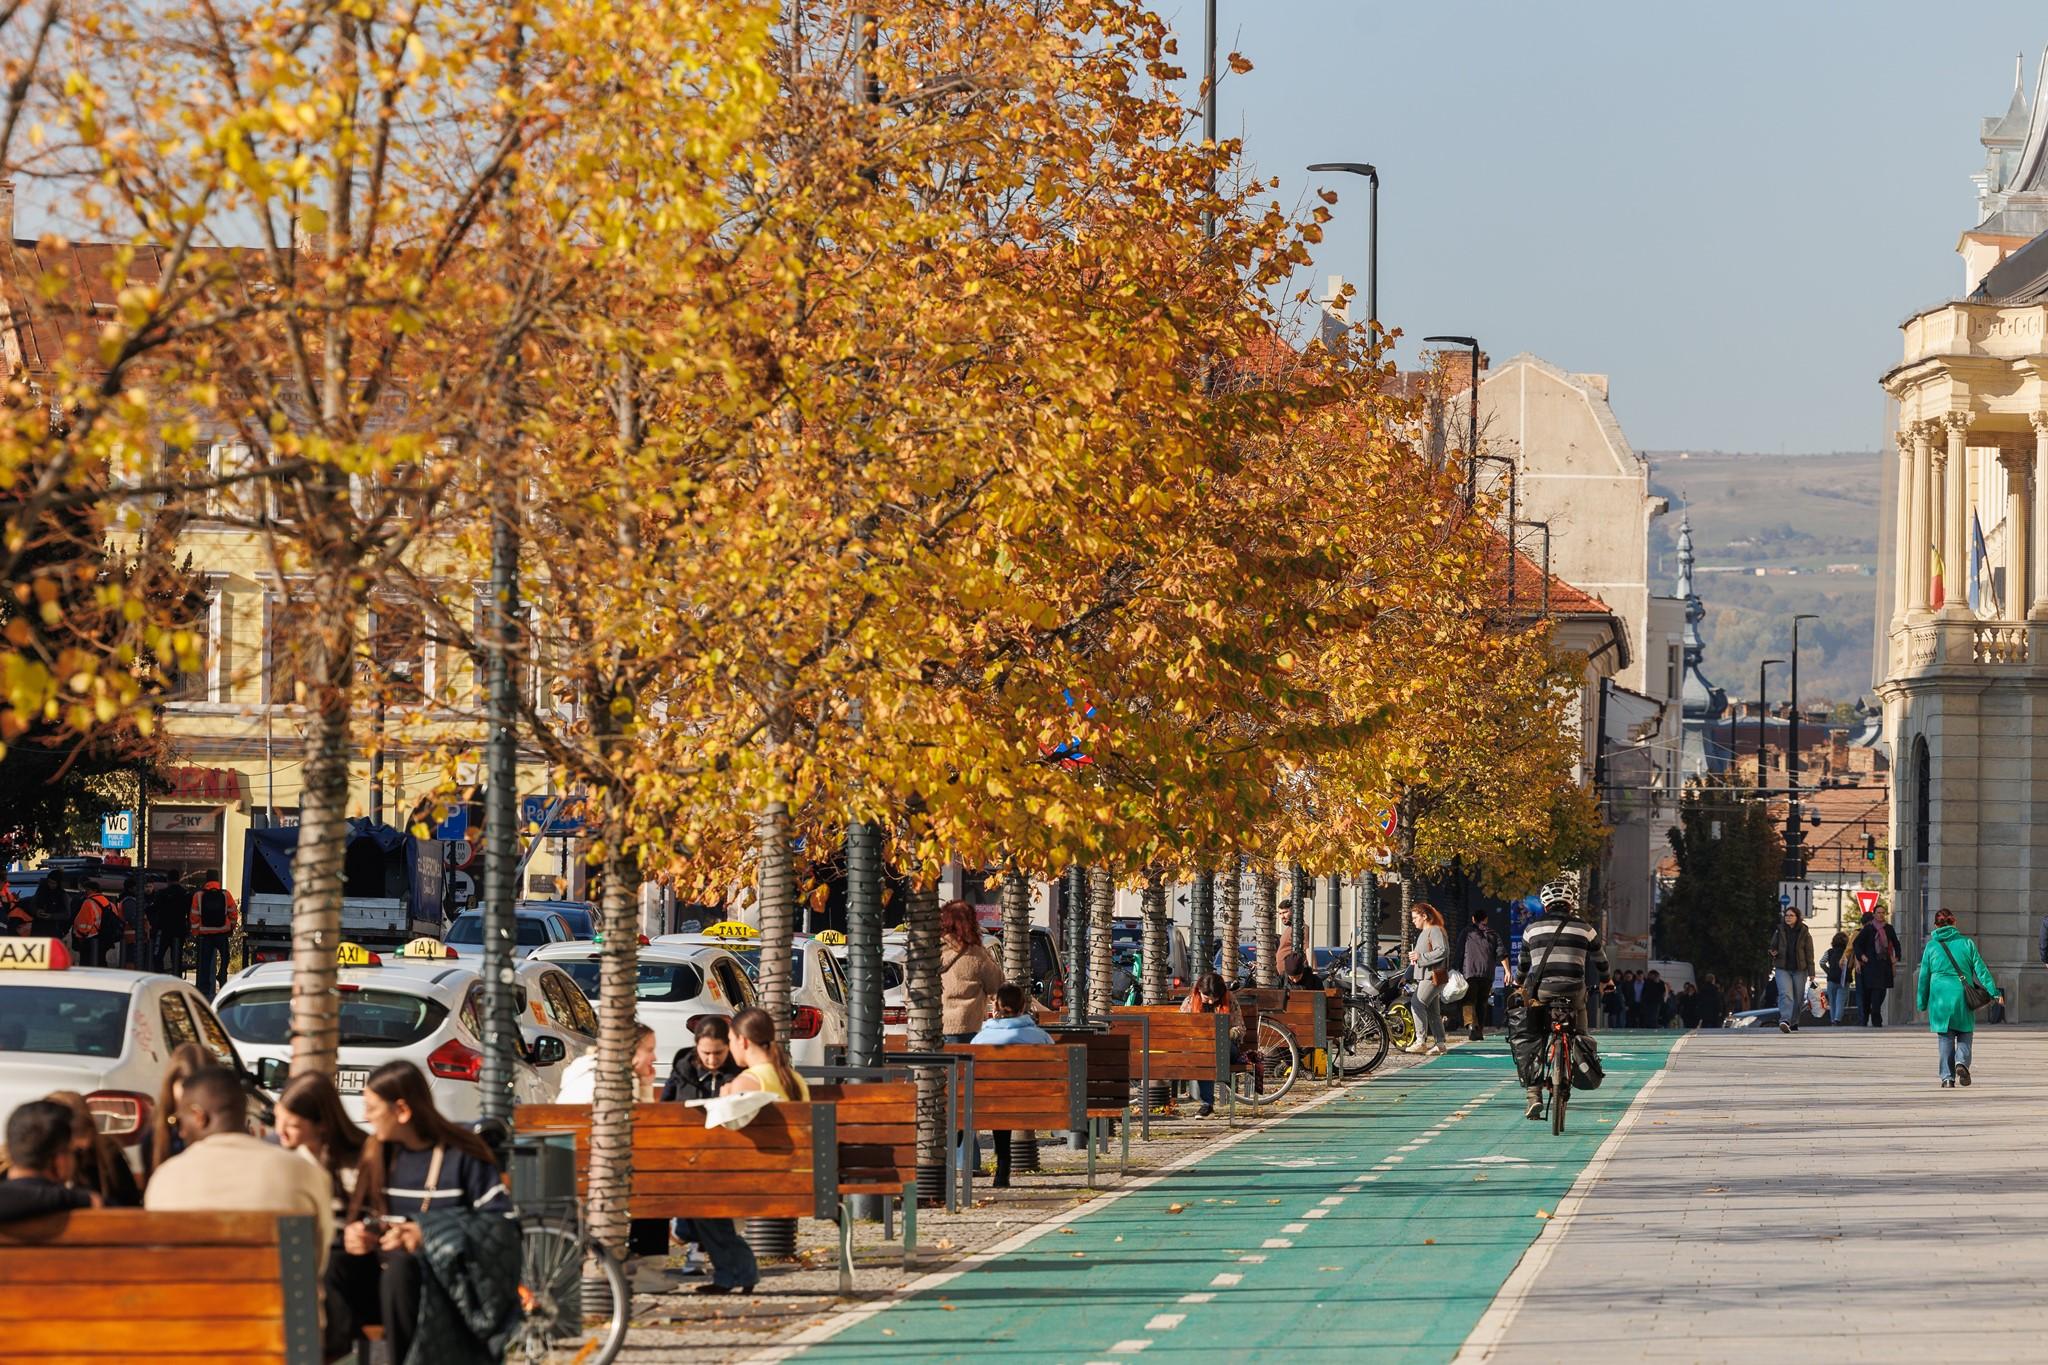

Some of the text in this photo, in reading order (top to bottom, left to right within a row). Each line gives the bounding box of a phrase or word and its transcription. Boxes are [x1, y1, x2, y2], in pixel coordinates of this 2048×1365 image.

[107, 816, 127, 831] WC
[719, 925, 747, 936] TAXI
[822, 932, 839, 943] TAXI
[0, 943, 45, 963] AXI
[337, 946, 359, 962] AXI
[414, 940, 437, 956] TAXI
